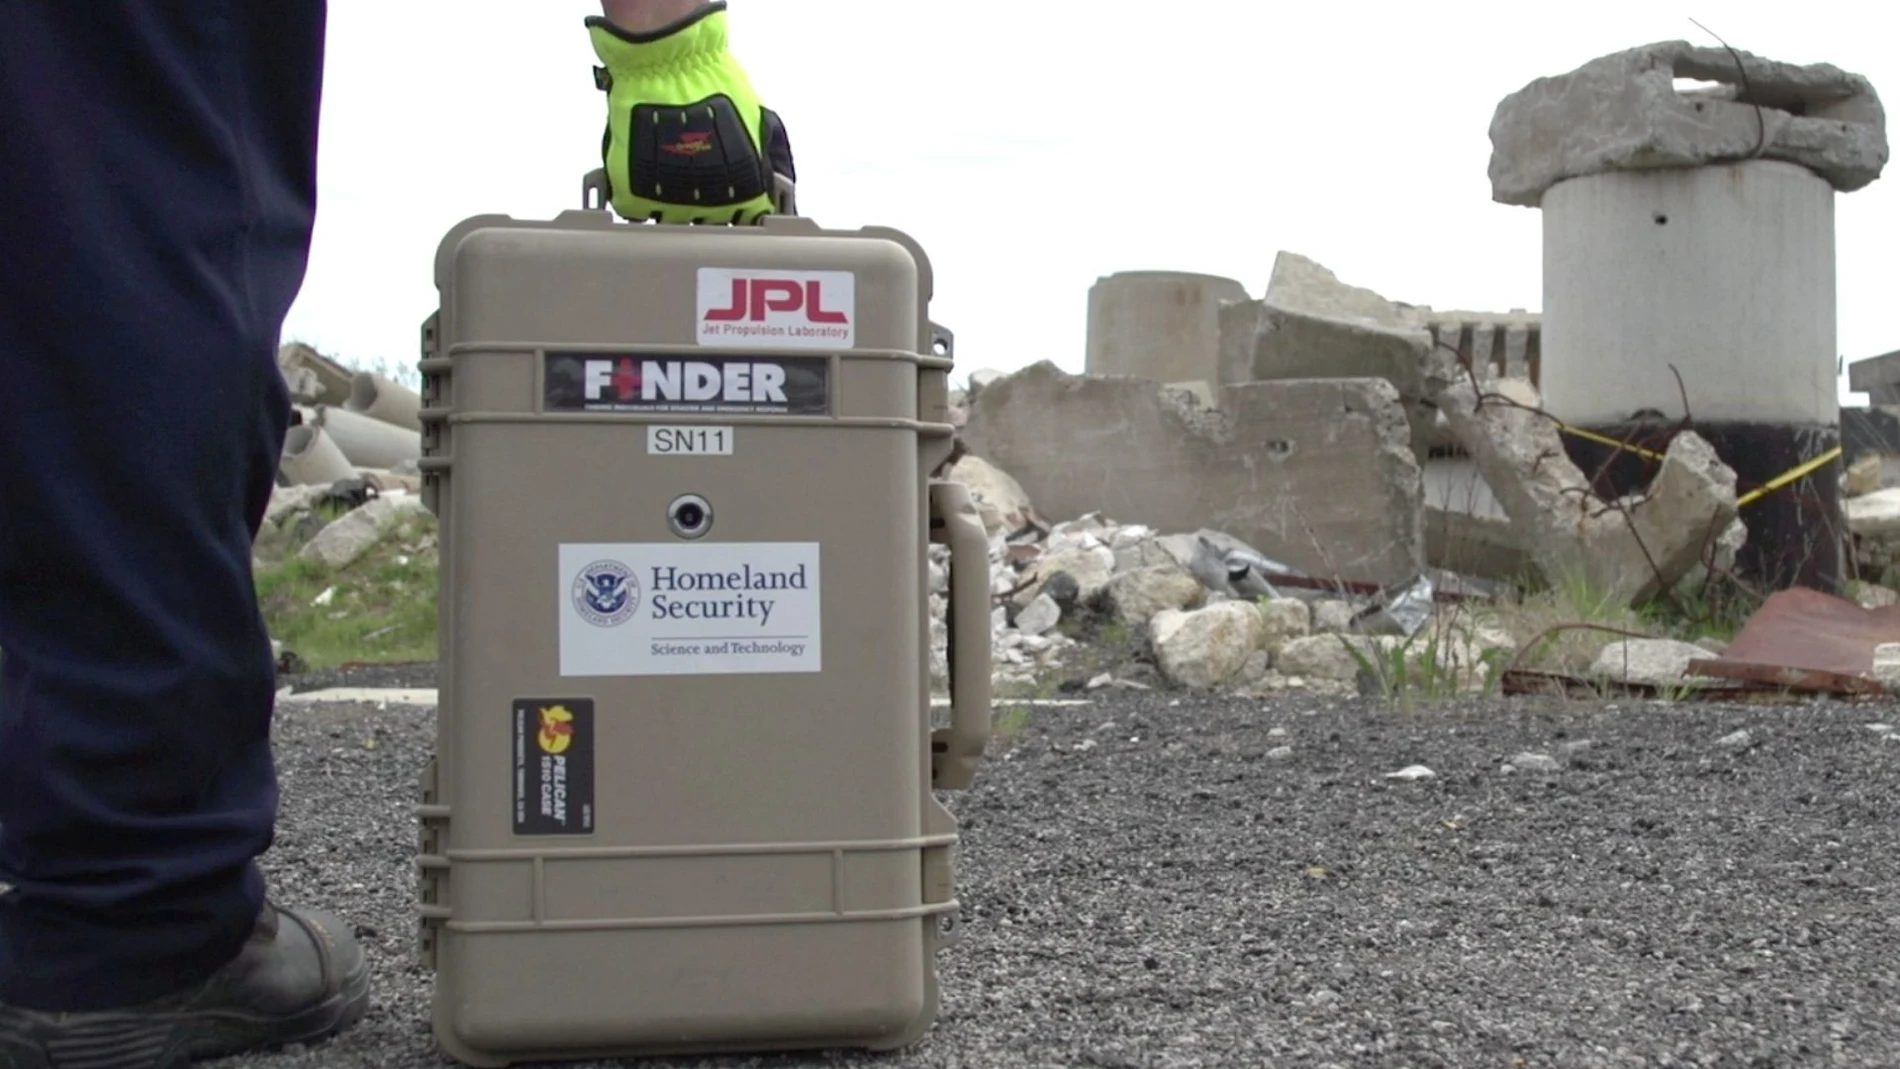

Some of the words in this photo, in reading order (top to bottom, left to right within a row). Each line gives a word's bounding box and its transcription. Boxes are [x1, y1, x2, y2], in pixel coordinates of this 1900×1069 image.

[703, 278, 849, 324] JPL
[702, 324, 720, 335] Jet
[724, 324, 784, 337] Propulsion
[788, 325, 849, 340] Laboratory
[654, 428, 724, 453] SN11
[651, 563, 808, 591] Homeland
[651, 594, 775, 626] Security
[651, 642, 700, 656] Science
[704, 642, 728, 655] and
[731, 641, 806, 657] Technology
[541, 783, 552, 816] CASE
[553, 754, 567, 822] PELICAN
